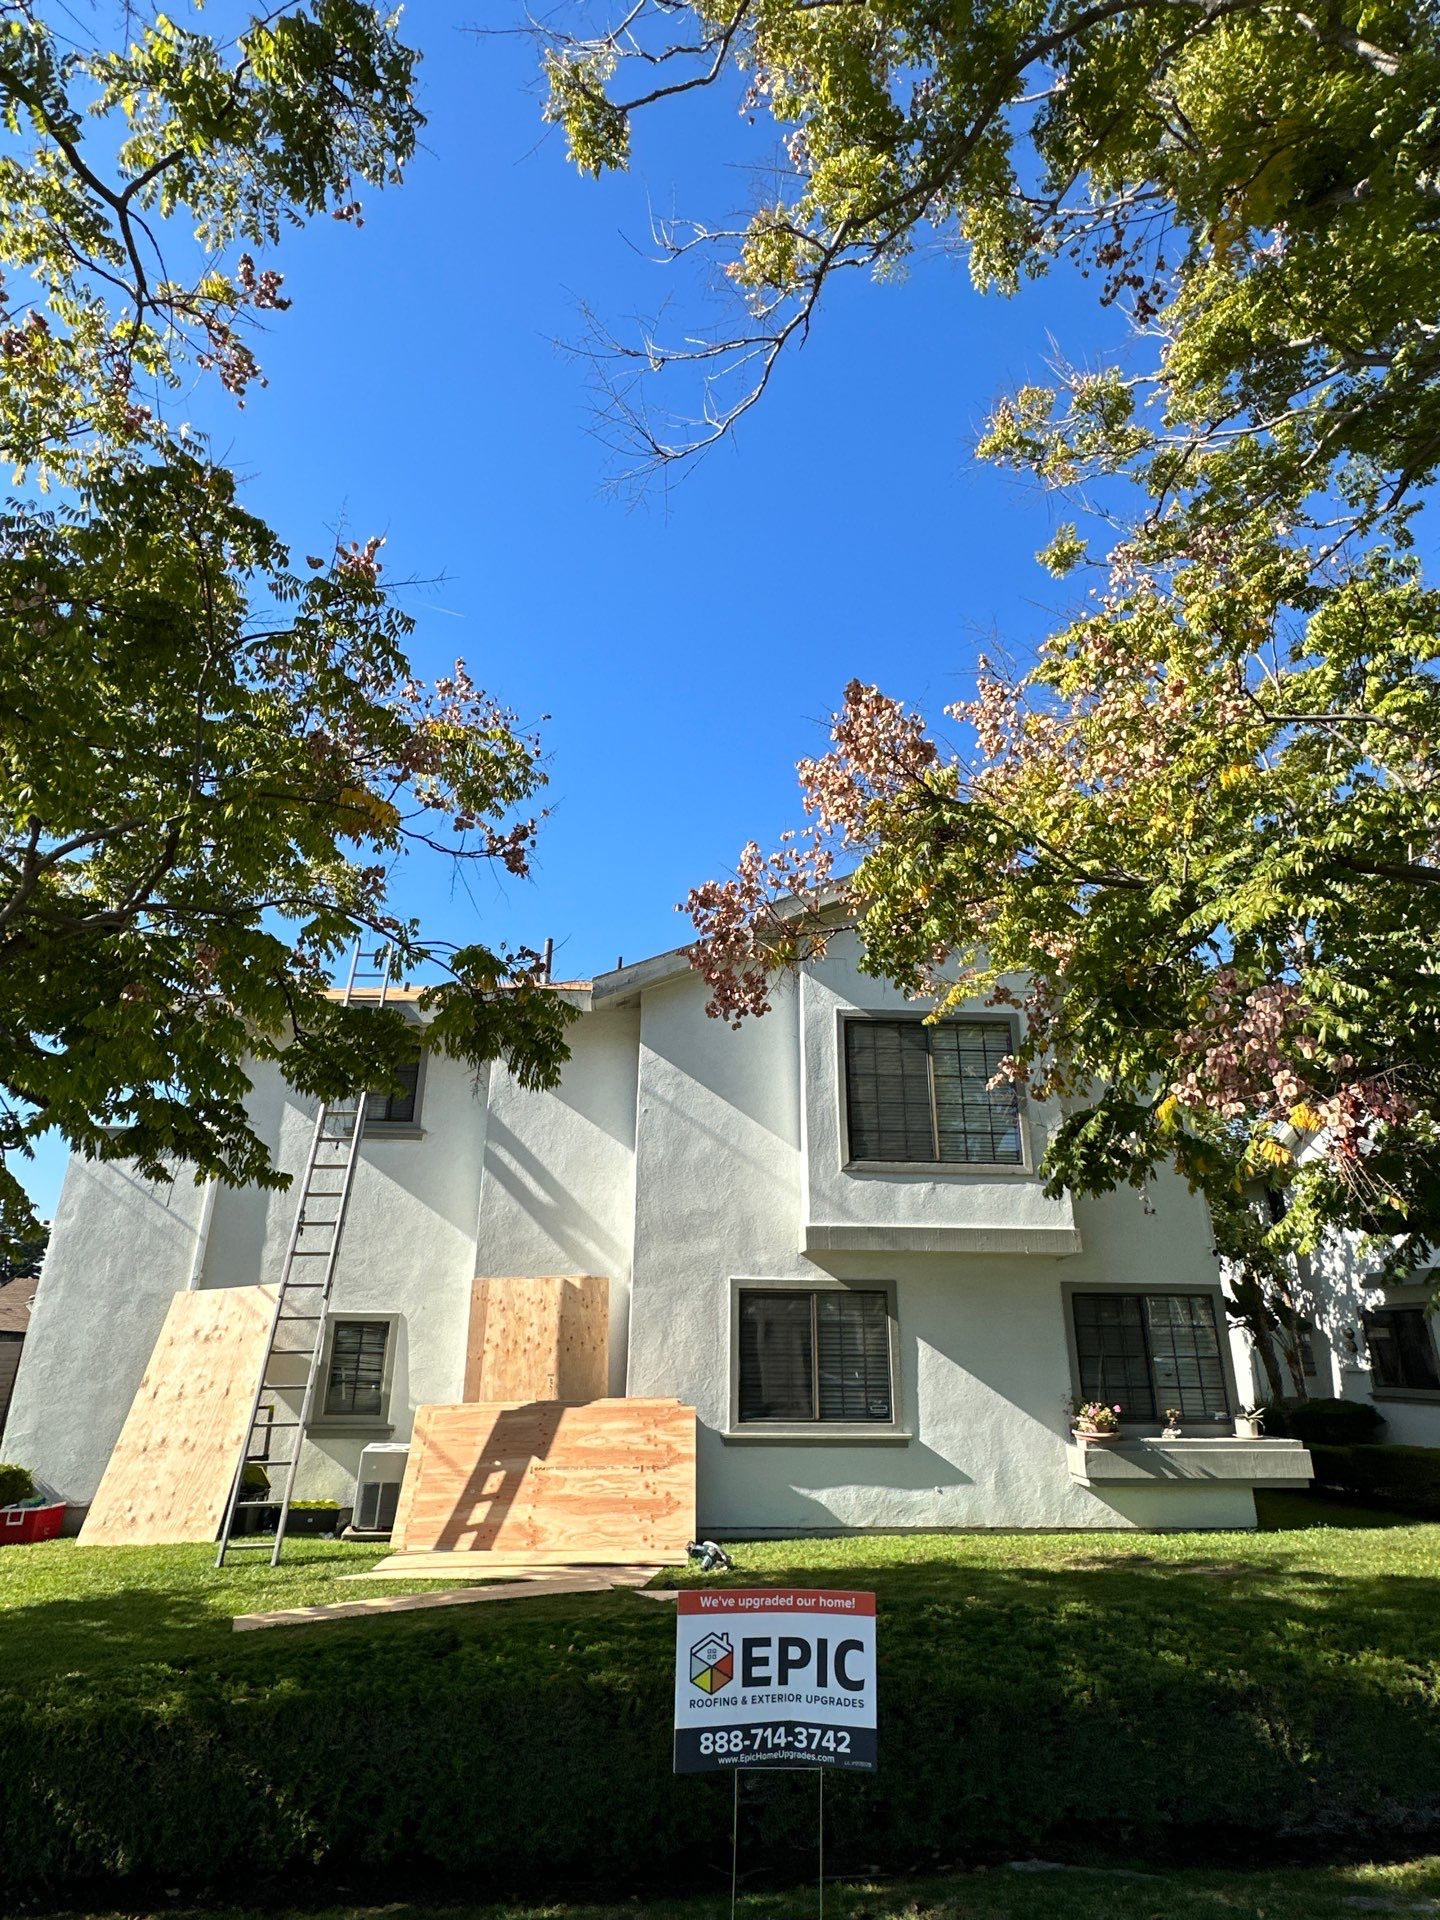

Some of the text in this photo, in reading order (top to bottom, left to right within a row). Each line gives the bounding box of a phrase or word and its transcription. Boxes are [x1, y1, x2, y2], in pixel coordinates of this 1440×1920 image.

[700, 1595, 856, 1610] We've upgraded our home!
[742, 1636, 866, 1692] EPIC
[689, 1693, 865, 1709] ROOFING & EXTERIOR UPGRADES
[699, 1726, 852, 1755] 888-714-3742
[718, 1750, 835, 1765] www.EpicHomeUpgrades.com
